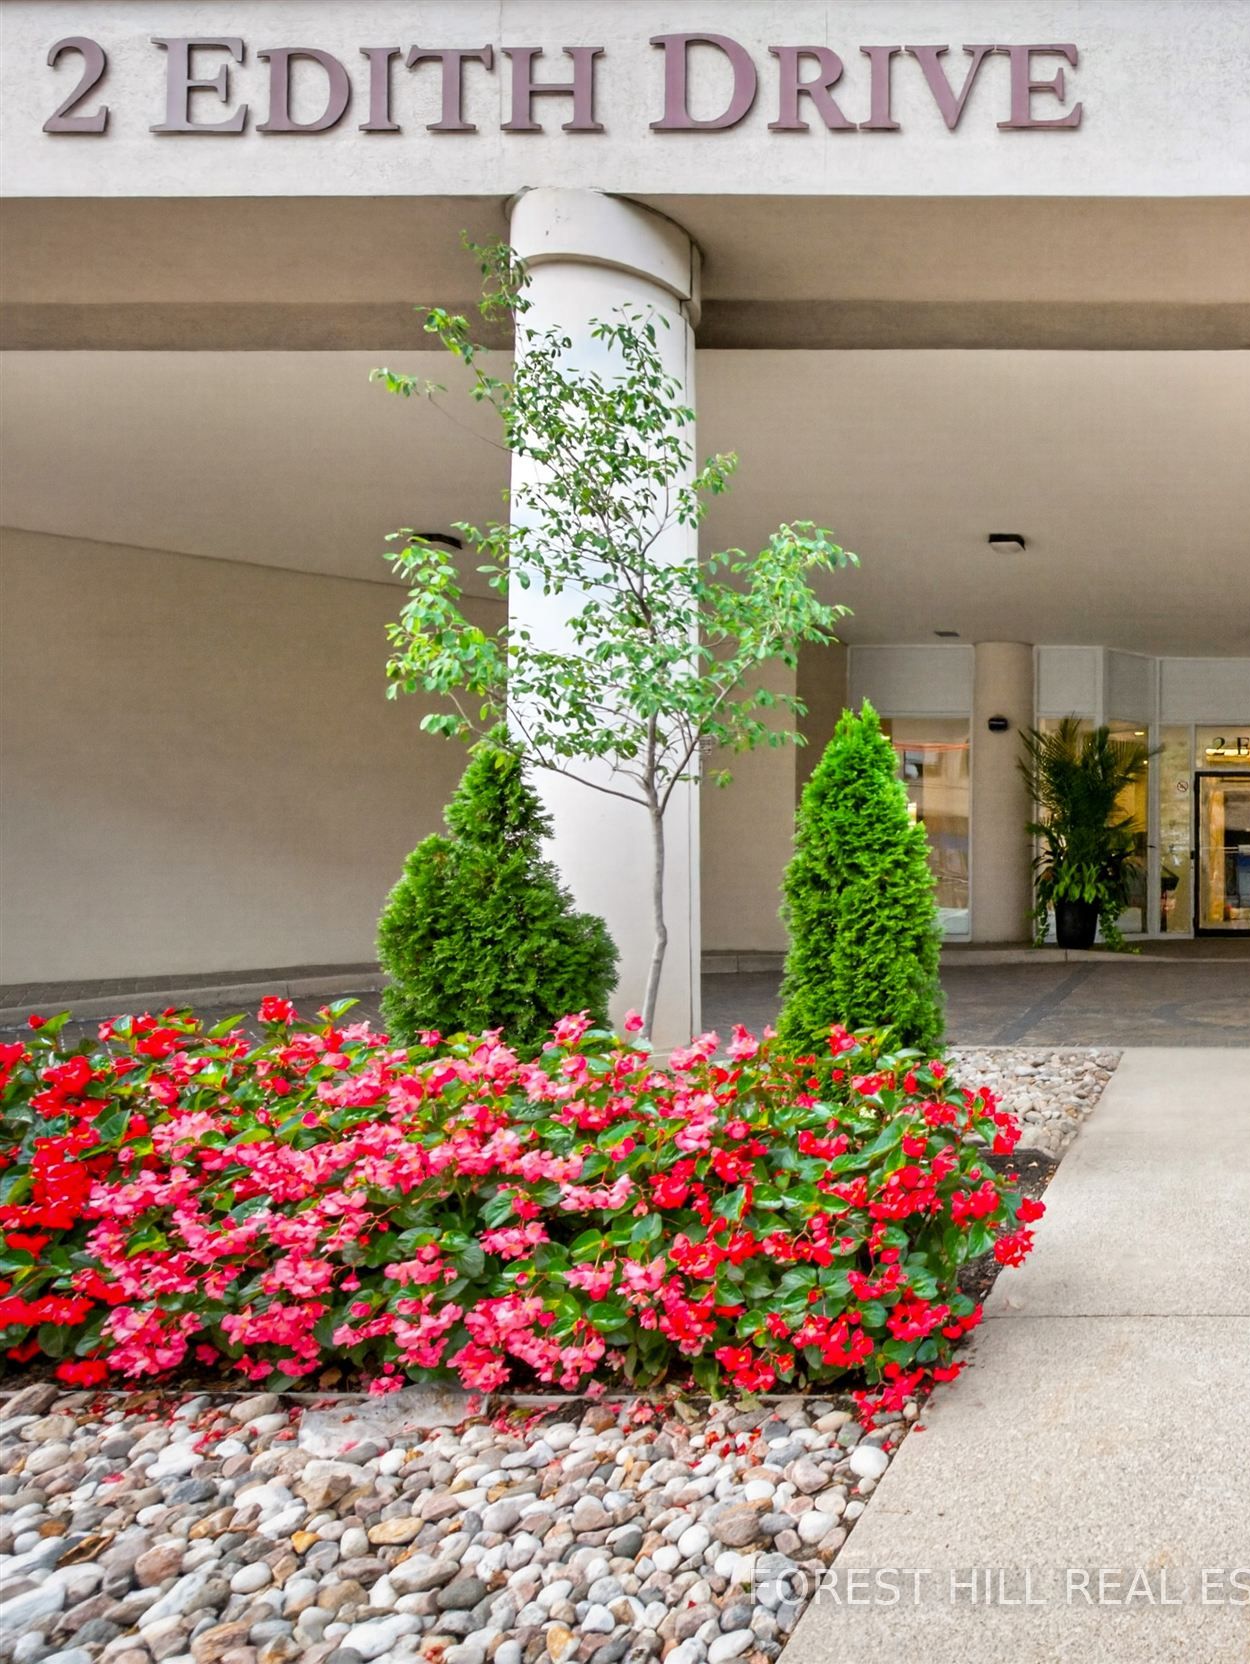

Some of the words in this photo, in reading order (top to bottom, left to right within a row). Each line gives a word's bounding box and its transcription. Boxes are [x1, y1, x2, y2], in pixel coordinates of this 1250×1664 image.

[43, 36, 109, 134] 2
[149, 36, 604, 134] EDITH
[649, 32, 1083, 132] DRIVE
[1213, 736, 1226, 755] 2
